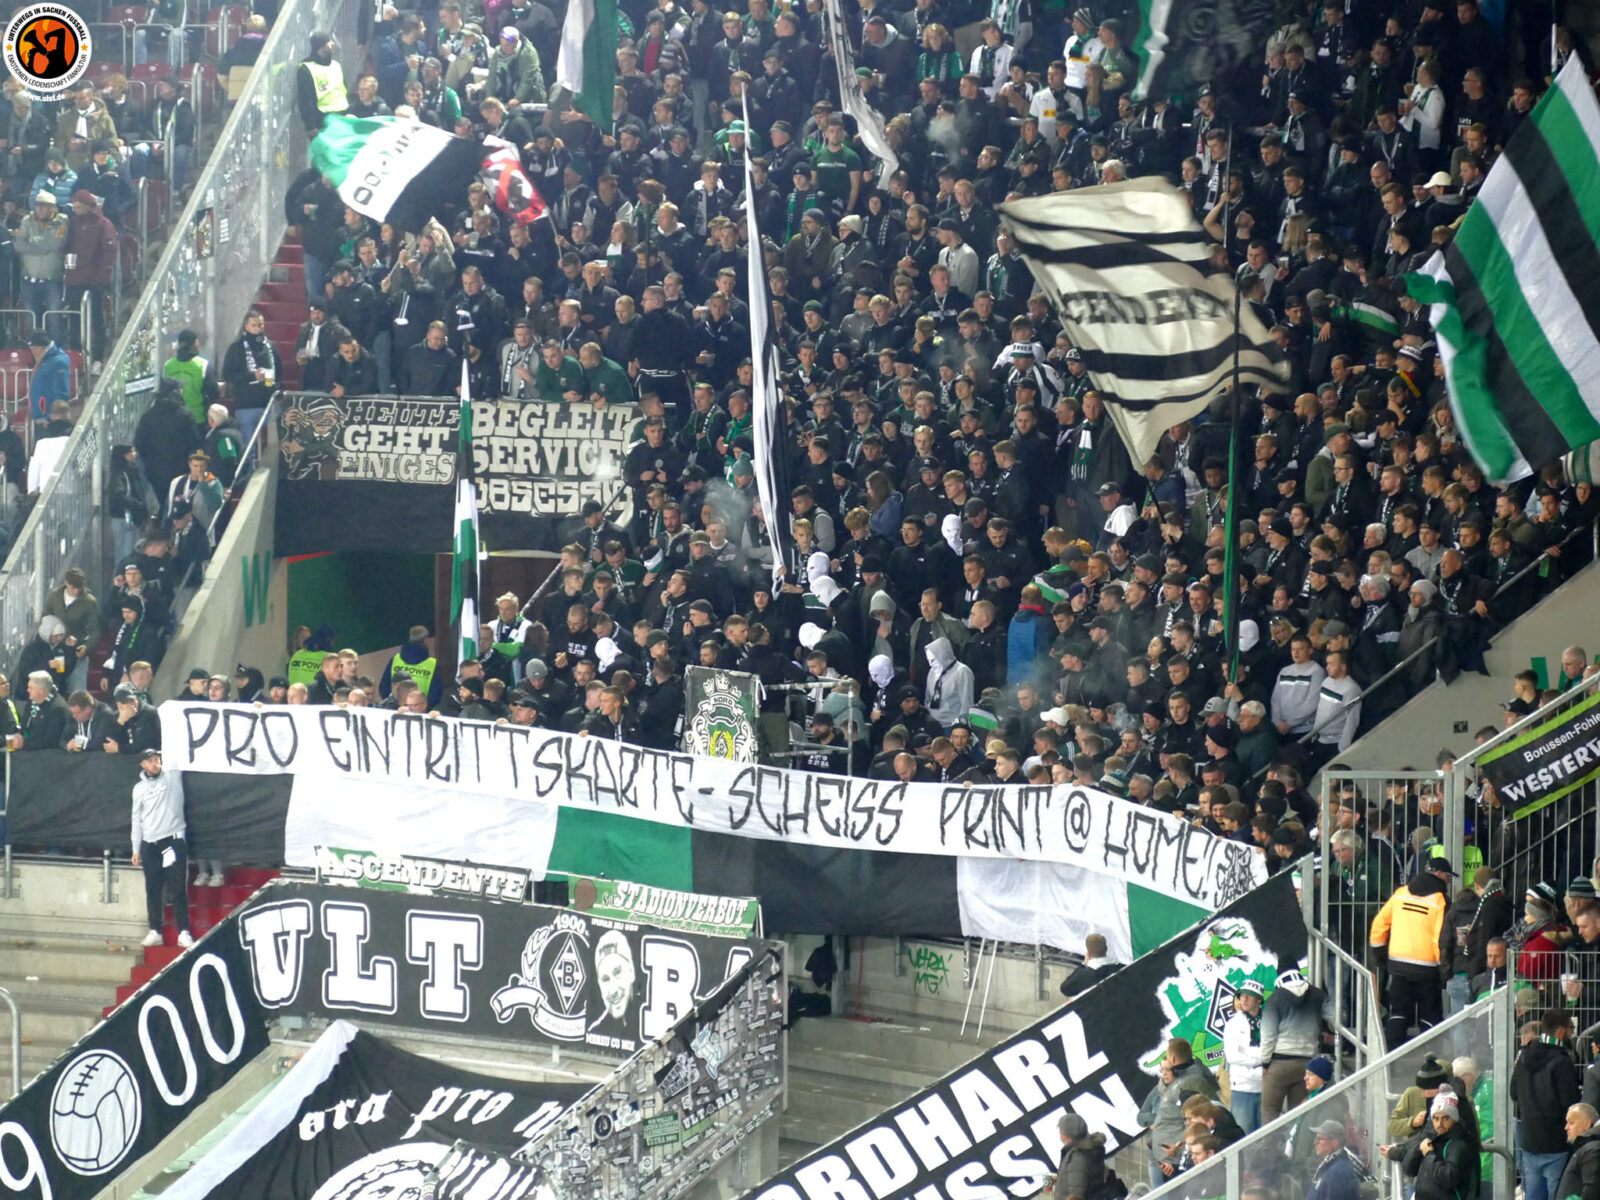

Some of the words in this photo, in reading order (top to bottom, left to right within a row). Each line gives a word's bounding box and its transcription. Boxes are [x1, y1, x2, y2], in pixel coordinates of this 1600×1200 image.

[342, 399, 461, 431] HEUTE
[471, 401, 633, 440] BEGLEIT
[343, 424, 450, 455] GEHT
[472, 437, 622, 477] SERVICE
[336, 451, 457, 485] EINIGES
[183, 707, 298, 767] PRO
[728, 765, 909, 846] SCHEISS
[939, 785, 1053, 853] PRINT
[1063, 790, 1092, 853] @
[320, 852, 529, 903] ASCENDENTE
[616, 881, 748, 926] STADIONVERBOT
[553, 914, 586, 935] 1900
[298, 1089, 393, 1141] ora
[399, 1086, 515, 1140] pro
[754, 1010, 1110, 1200] RDHARZ
